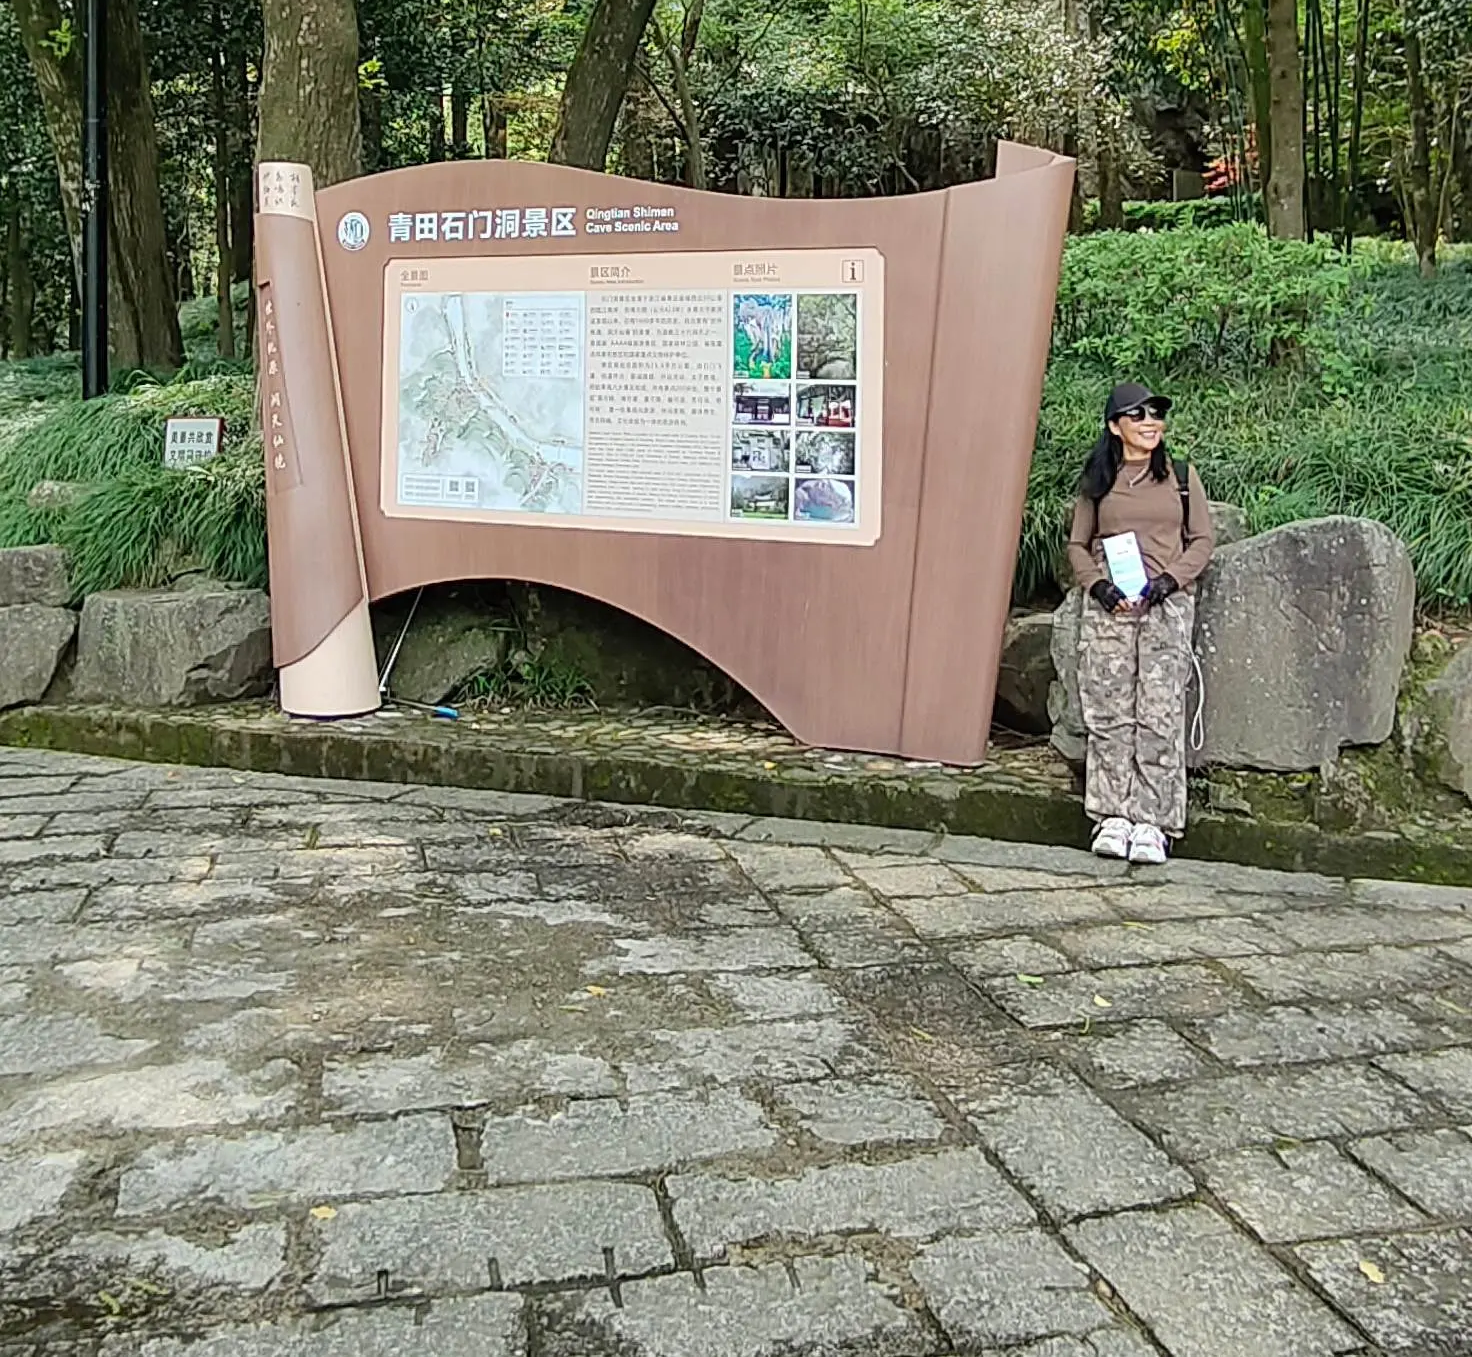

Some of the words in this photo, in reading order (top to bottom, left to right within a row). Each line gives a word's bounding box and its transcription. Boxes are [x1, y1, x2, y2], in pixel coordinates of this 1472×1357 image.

[586, 208, 630, 223] Qingtian
[633, 206, 675, 218] Shimen
[388, 207, 577, 242] 青田石门洞景区
[585, 222, 612, 234] Cave
[614, 220, 651, 233] Scenic
[652, 219, 679, 232] Area
[590, 266, 631, 278] 景区简介
[734, 263, 779, 275] 景点照片
